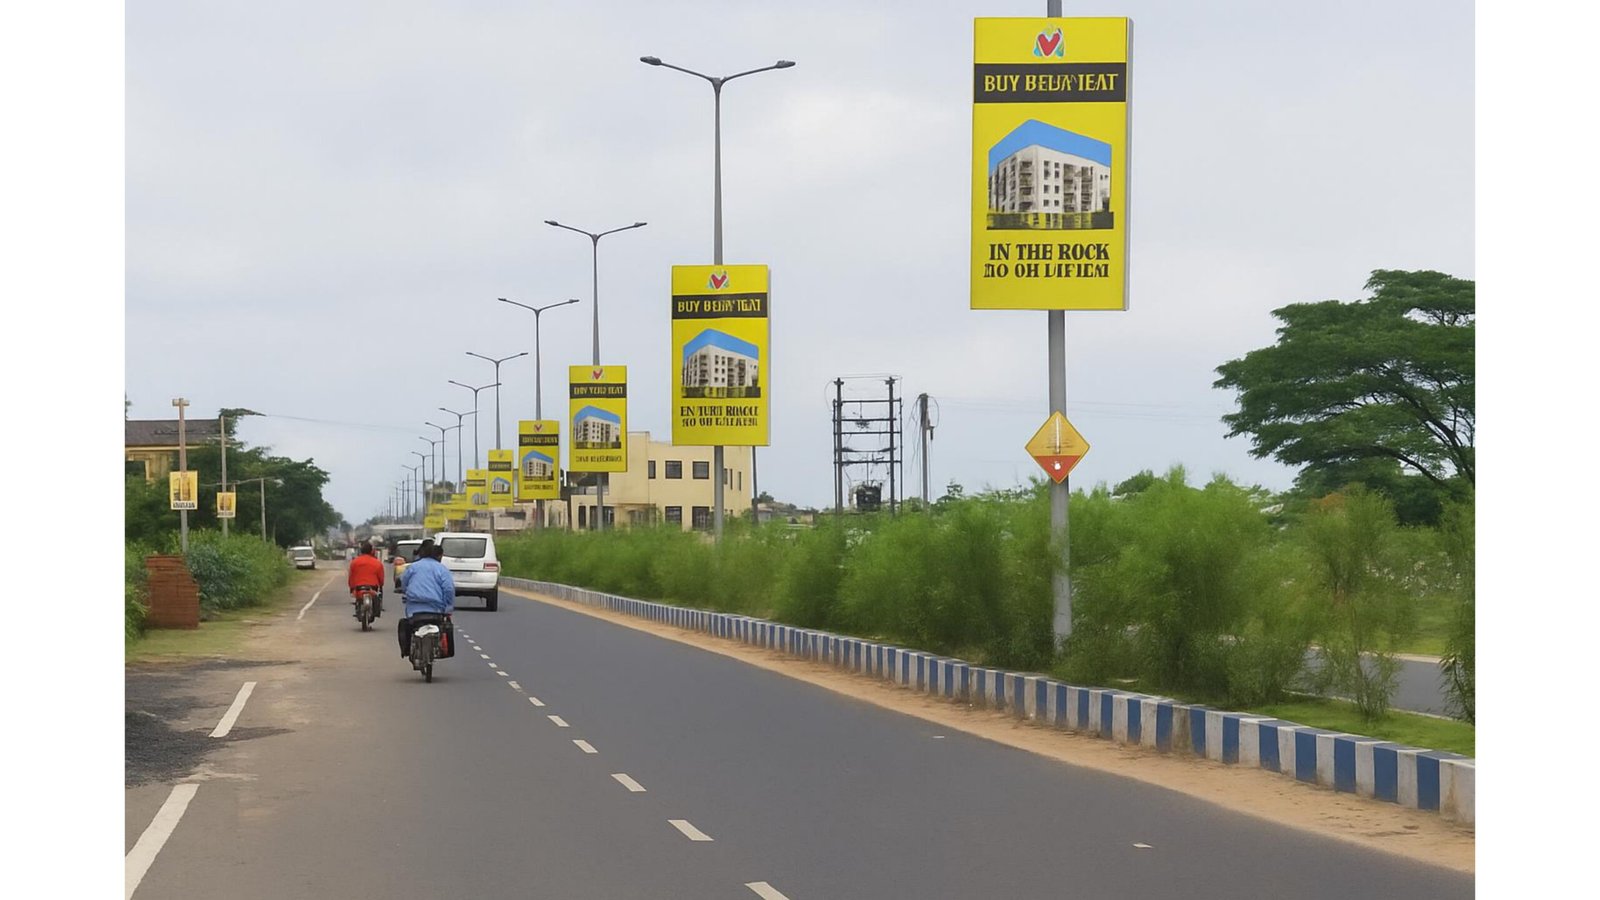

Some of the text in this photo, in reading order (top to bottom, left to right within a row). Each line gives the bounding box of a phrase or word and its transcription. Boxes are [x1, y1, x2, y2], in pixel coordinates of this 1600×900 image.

[984, 74, 1020, 92] BUY
[989, 243, 1110, 260] IN THE ROCK
[1014, 263, 1039, 278] OH
[677, 300, 701, 313] BUY
